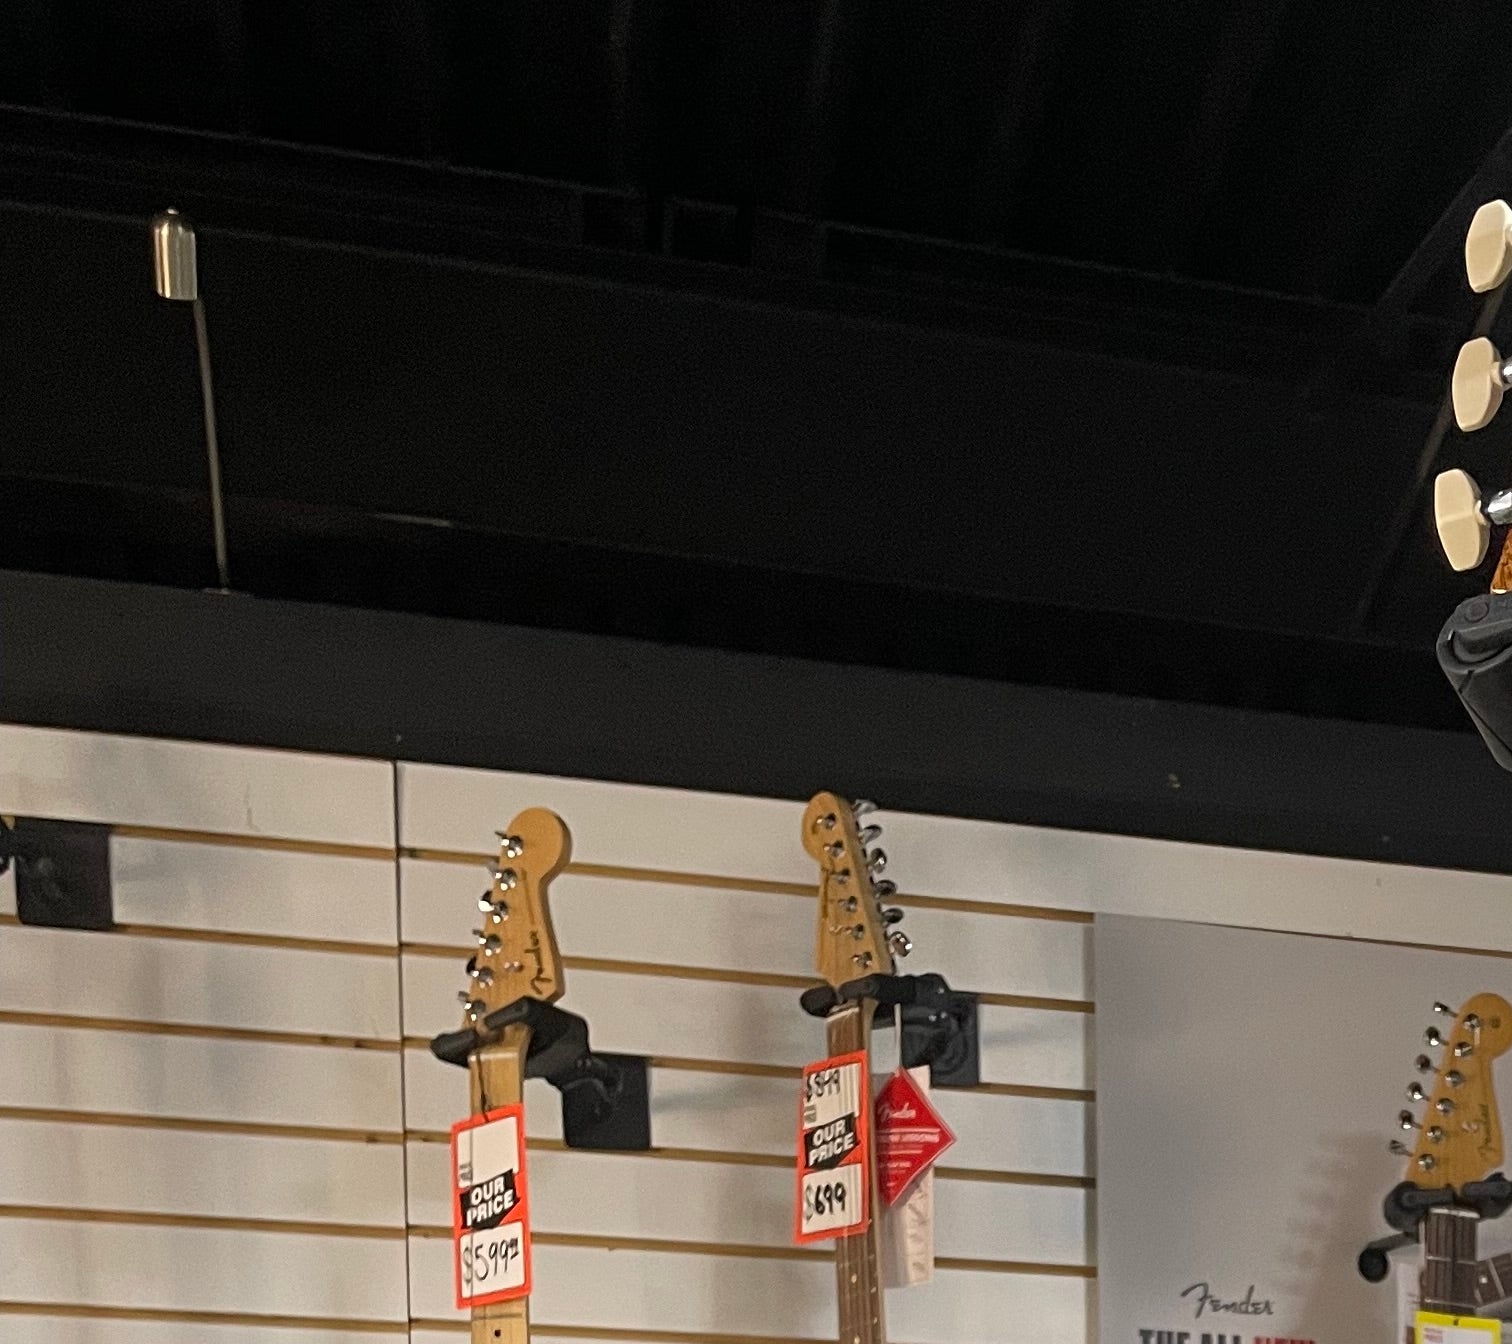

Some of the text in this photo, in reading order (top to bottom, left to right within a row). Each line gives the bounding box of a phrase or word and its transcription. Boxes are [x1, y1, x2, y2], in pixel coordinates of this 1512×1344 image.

[808, 1133, 854, 1168] PRICE
[813, 1119, 846, 1147] OUR
[466, 1189, 514, 1227] PRICE
[471, 1176, 505, 1207] OUR
[1181, 1283, 1274, 1318] Fender
